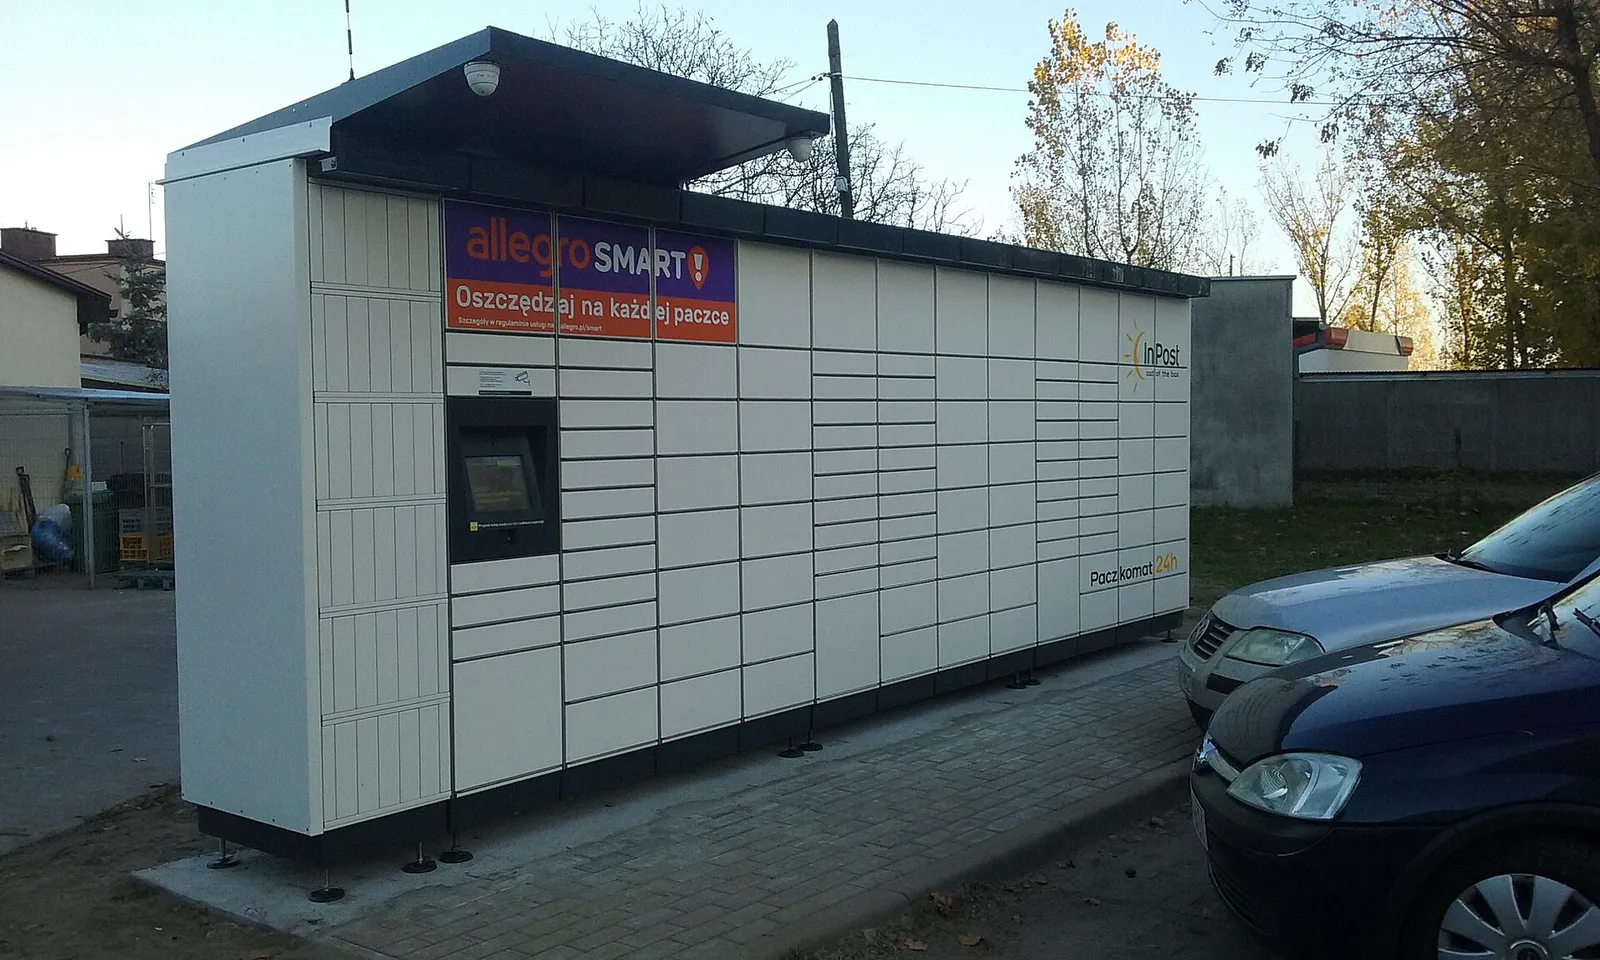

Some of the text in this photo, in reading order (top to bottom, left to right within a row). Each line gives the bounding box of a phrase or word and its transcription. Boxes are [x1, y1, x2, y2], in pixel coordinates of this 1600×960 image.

[466, 216, 590, 277] allegro
[456, 285, 730, 327] Oszczędzaj na każdej paczce
[1143, 341, 1180, 367] InPost
[1090, 551, 1178, 587] Paczkomat 24h
